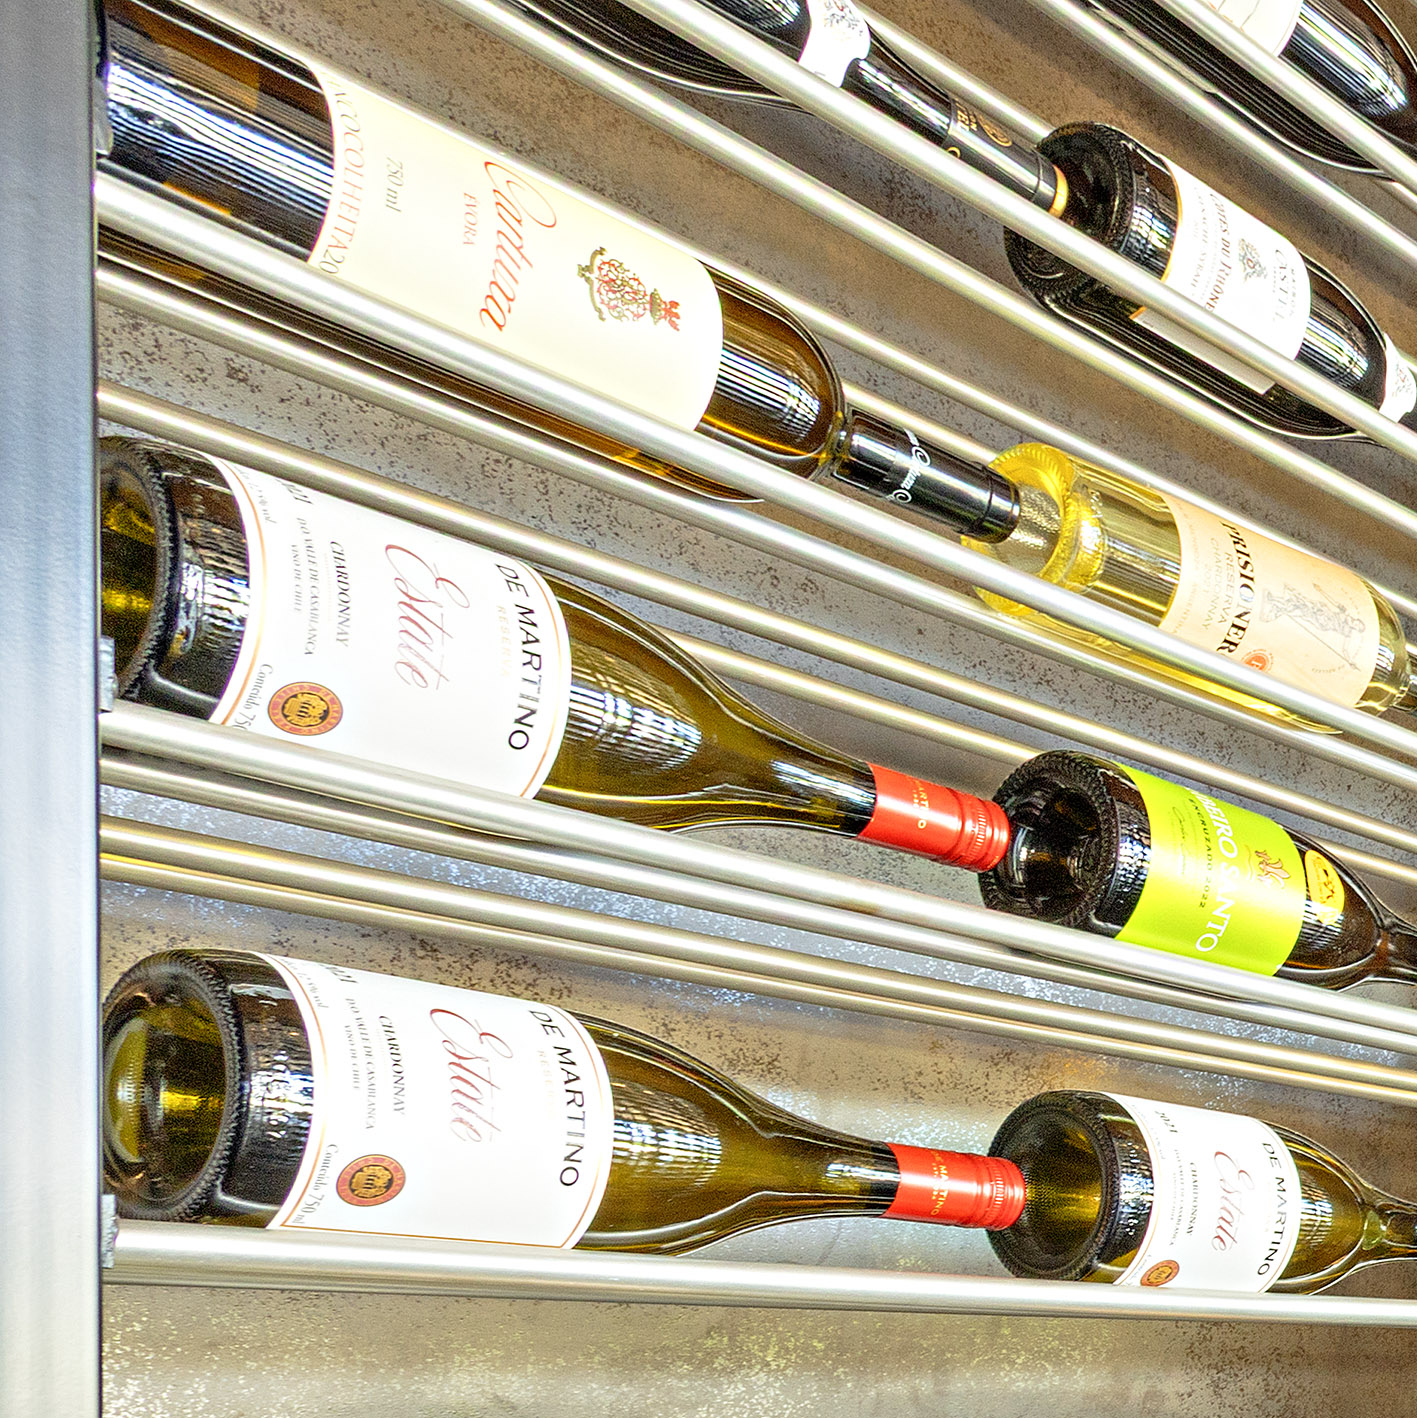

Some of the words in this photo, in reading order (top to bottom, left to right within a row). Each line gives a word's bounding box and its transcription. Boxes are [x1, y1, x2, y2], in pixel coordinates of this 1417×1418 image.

[384, 155, 404, 187] 750
[462, 191, 479, 246] ÉVORA
[479, 161, 557, 332] Cartuxa
[1208, 193, 1230, 243] CÔTES
[318, 250, 346, 275] 20
[1203, 260, 1232, 313] RHÔNE
[1274, 248, 1288, 322] CASTEL
[330, 540, 352, 647] CHARDONNAY
[385, 544, 471, 690] Estate
[495, 562, 530, 598] DE
[1201, 537, 1221, 630] CHARDONNAY
[1216, 520, 1256, 655] PRISIONER
[1216, 552, 1237, 624] RESERVA
[304, 582, 320, 656] CASABLANCA
[242, 663, 274, 711] Conteúdo
[507, 602, 544, 750] MARTINO
[1189, 797, 1214, 871] ENCRUZADO
[1195, 862, 1239, 952] SANTO
[1198, 876, 1211, 909] 2022
[365, 1061, 377, 1131] CASABLANCA
[378, 1015, 406, 1116] CHARDONNAY
[430, 1008, 514, 1143] Estate
[528, 1009, 565, 1039] DE
[552, 1045, 586, 1187] MARTINO
[312, 1143, 340, 1191] Conteúdo
[1261, 1142, 1282, 1170] DE
[299, 1190, 325, 1215] 750
[1186, 1161, 1199, 1236] CHARDONNAY
[1211, 1151, 1256, 1252] Estate
[1257, 1176, 1287, 1276] MARTINO
